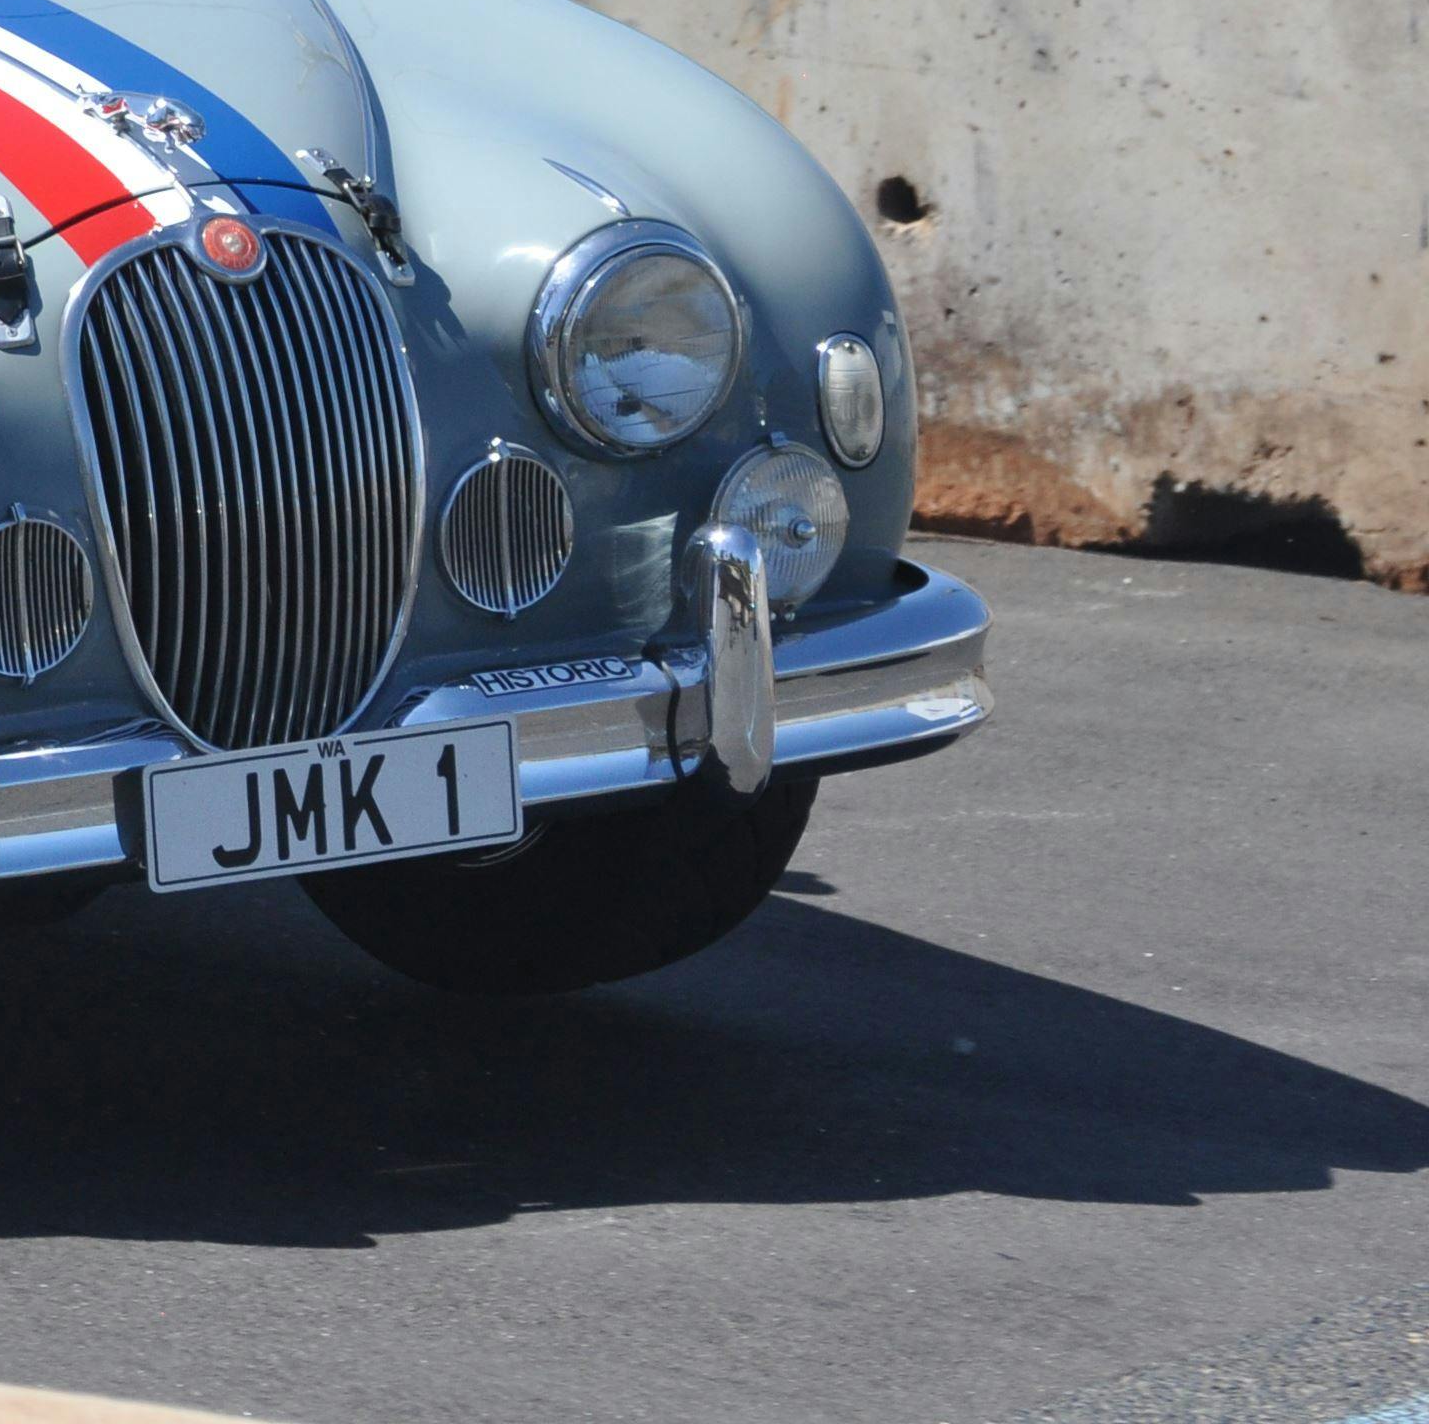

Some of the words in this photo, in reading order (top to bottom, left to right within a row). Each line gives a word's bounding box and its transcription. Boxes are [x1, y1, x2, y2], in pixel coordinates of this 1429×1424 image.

[478, 657, 629, 697] HISTORIC
[316, 741, 347, 759] WA
[211, 754, 394, 868] JMK
[436, 743, 460, 836] 1
